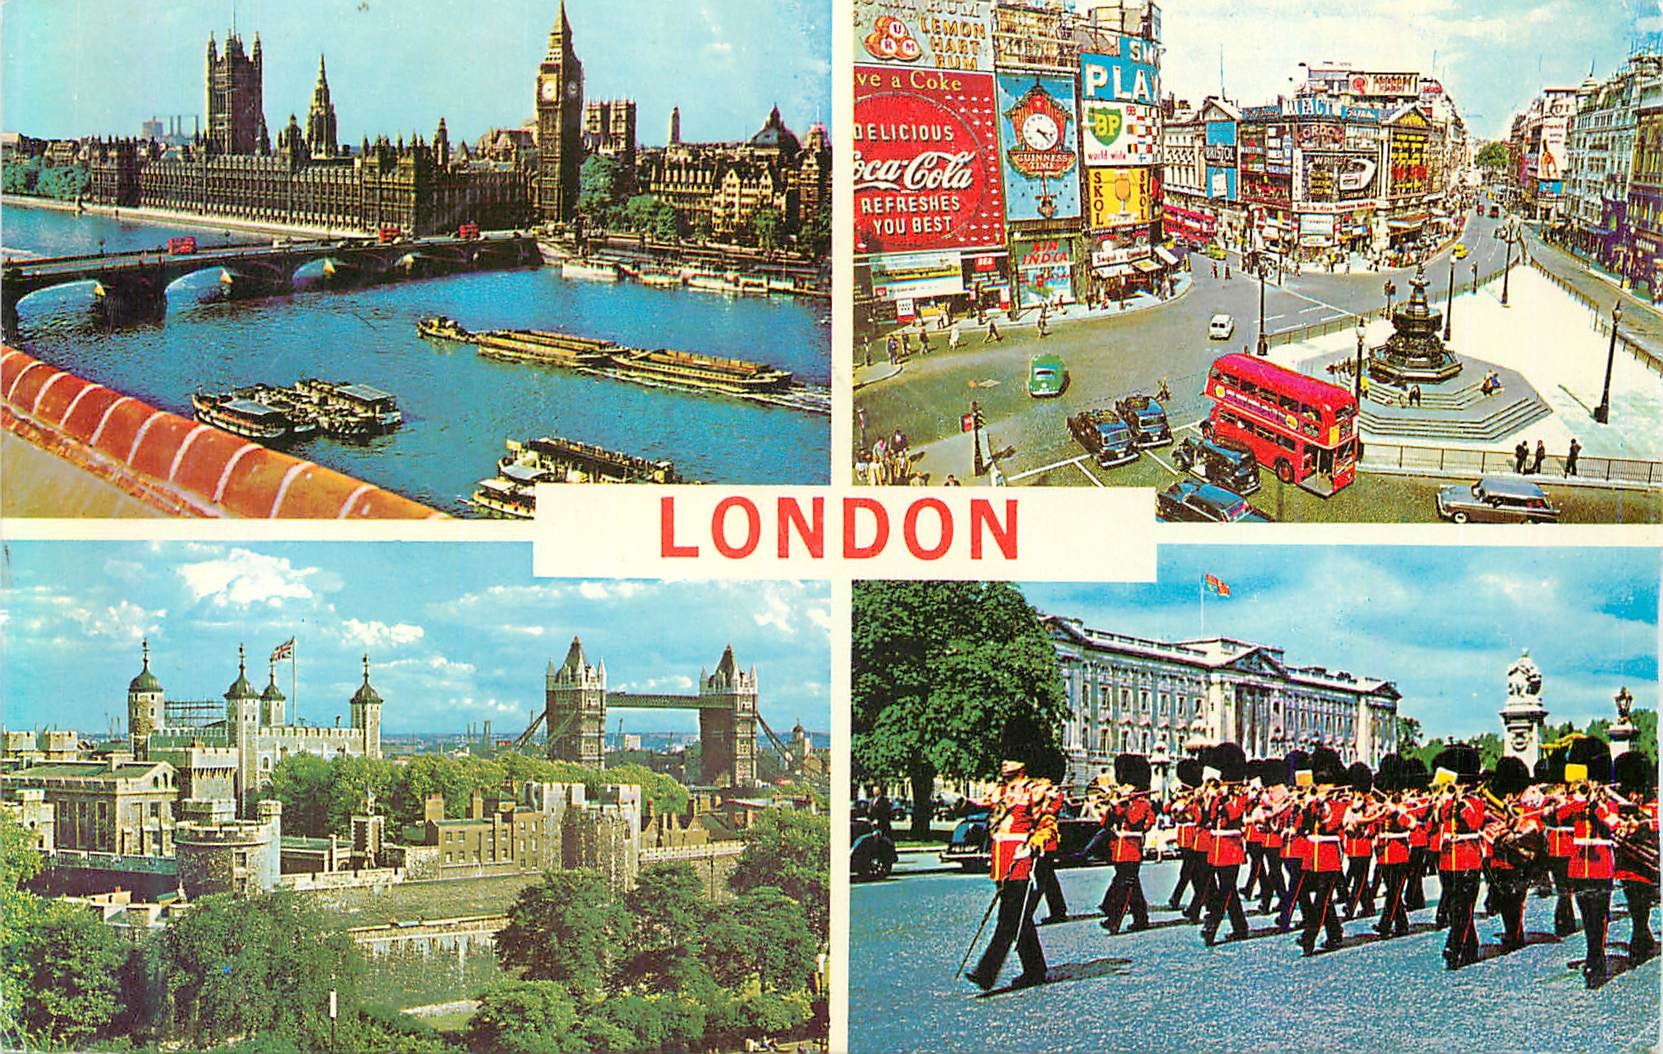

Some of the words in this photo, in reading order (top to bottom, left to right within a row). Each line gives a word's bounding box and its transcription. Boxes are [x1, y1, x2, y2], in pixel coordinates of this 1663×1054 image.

[920, 17, 986, 39] LEMON
[929, 35, 980, 55] HART
[934, 54, 977, 71] RUM
[892, 76, 901, 89] a
[910, 70, 962, 91] Coke
[853, 123, 954, 142] DELICIOUS
[1095, 113, 1120, 137] BP
[1016, 154, 1068, 163] GUINNESS
[1088, 150, 1108, 160] world
[853, 150, 977, 190] oca-Cola
[1030, 162, 1055, 170] TIME
[861, 195, 961, 214] REFRESHES
[1093, 172, 1104, 225] SKOL
[1139, 171, 1147, 220] SKOL
[873, 218, 906, 236] YOU
[912, 216, 952, 233] BEST
[1031, 241, 1060, 253] AIR
[1021, 252, 1069, 266] INDIA
